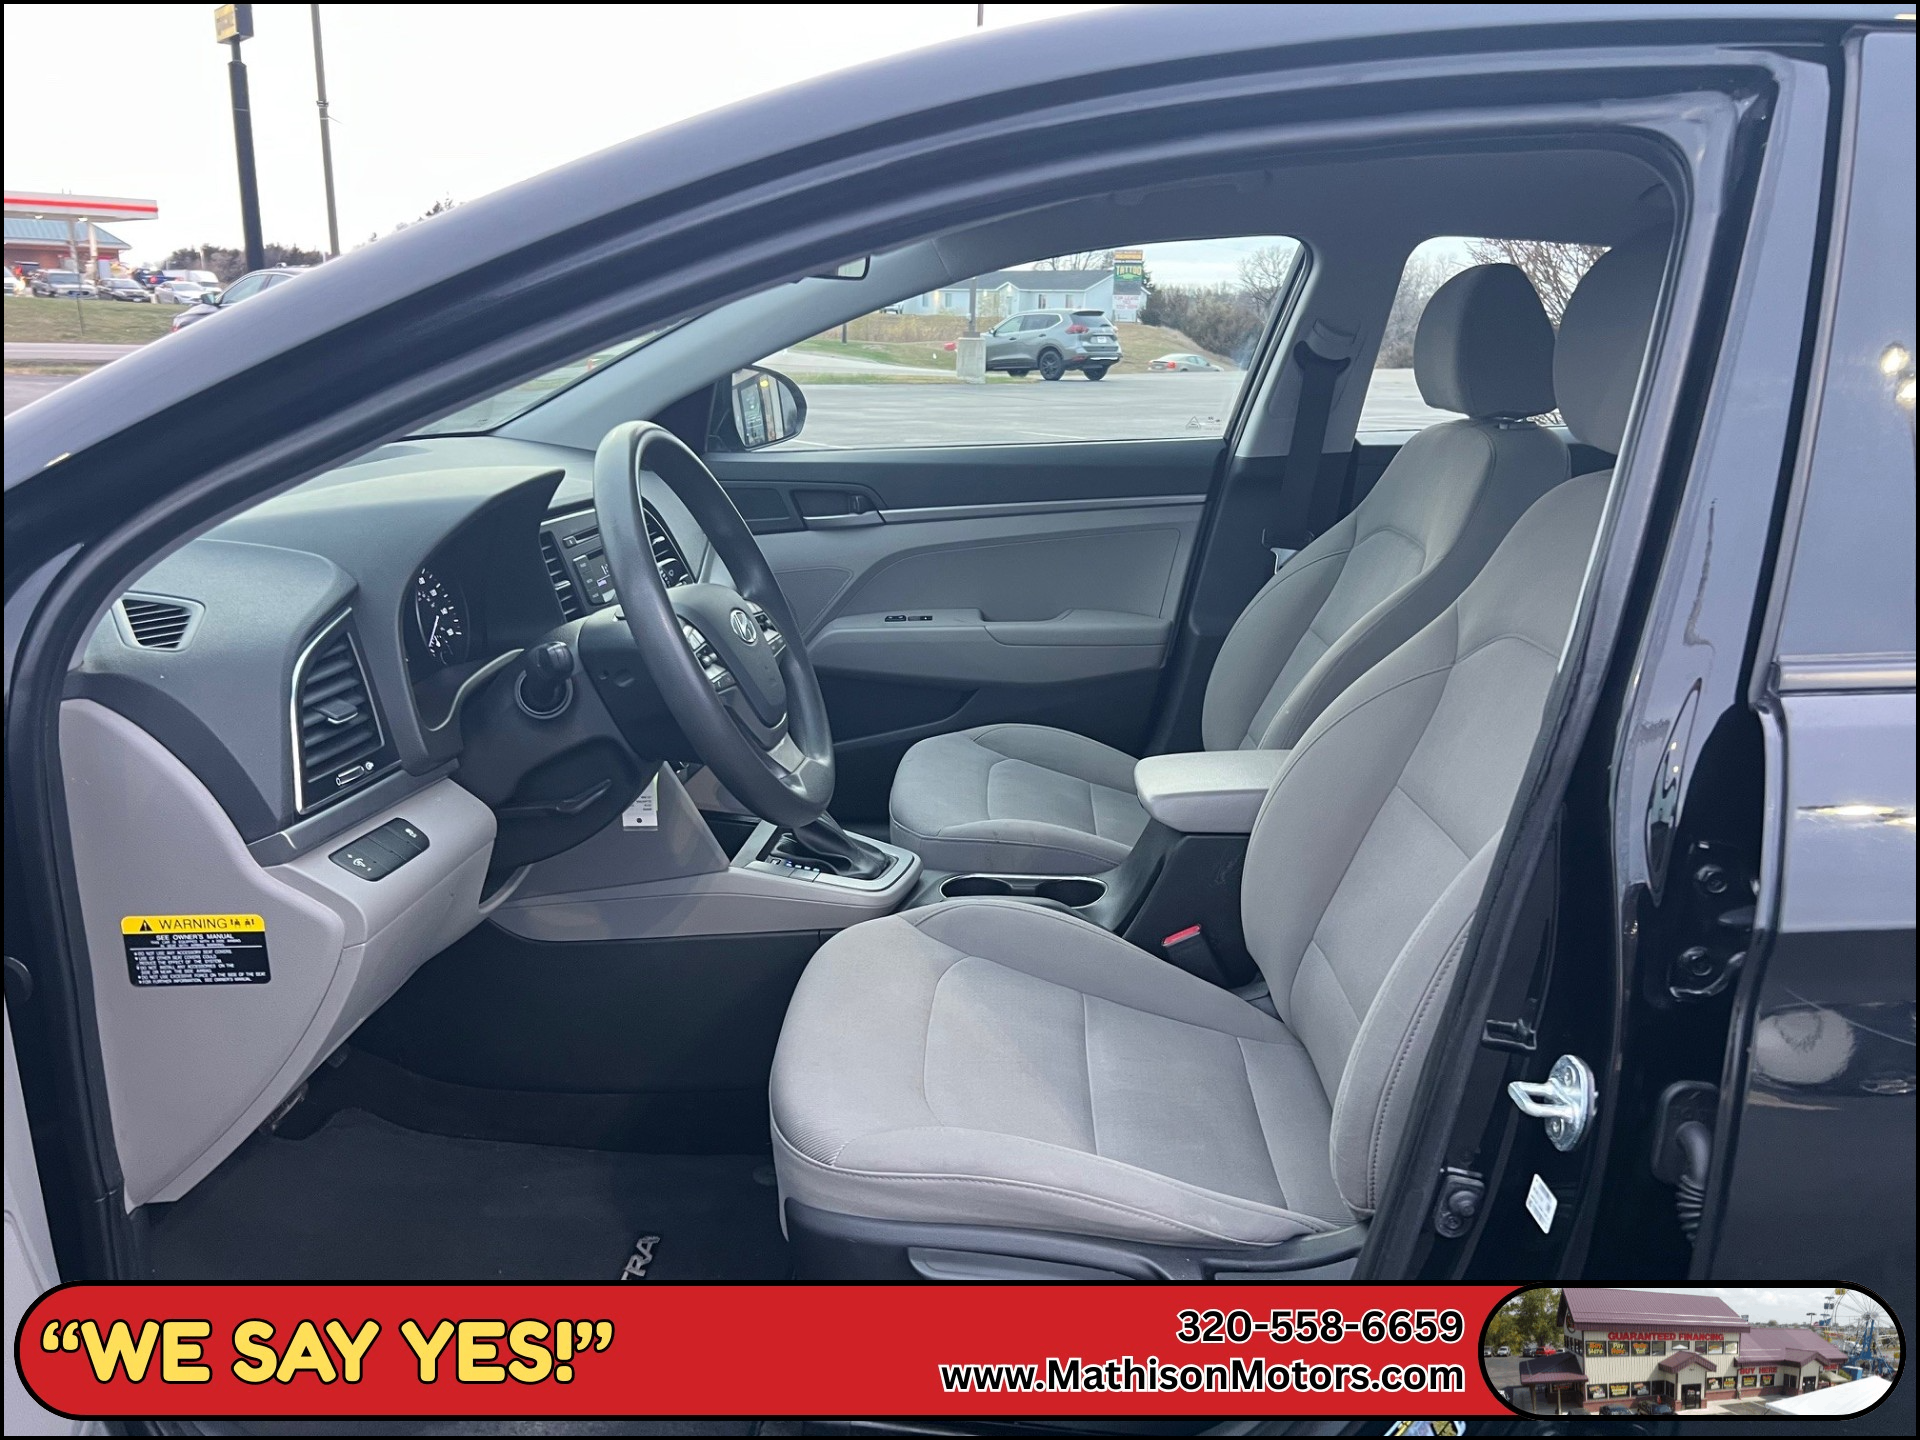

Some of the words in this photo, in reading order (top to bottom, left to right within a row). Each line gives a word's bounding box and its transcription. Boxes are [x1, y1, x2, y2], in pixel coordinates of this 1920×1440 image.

[1116, 265, 1142, 276] TATTOO
[159, 919, 227, 930] WARNING
[1608, 1332, 1676, 1340] GUARANTEED
[1679, 1333, 1724, 1341] FINANCING
[1759, 1366, 1777, 1374] HERE
